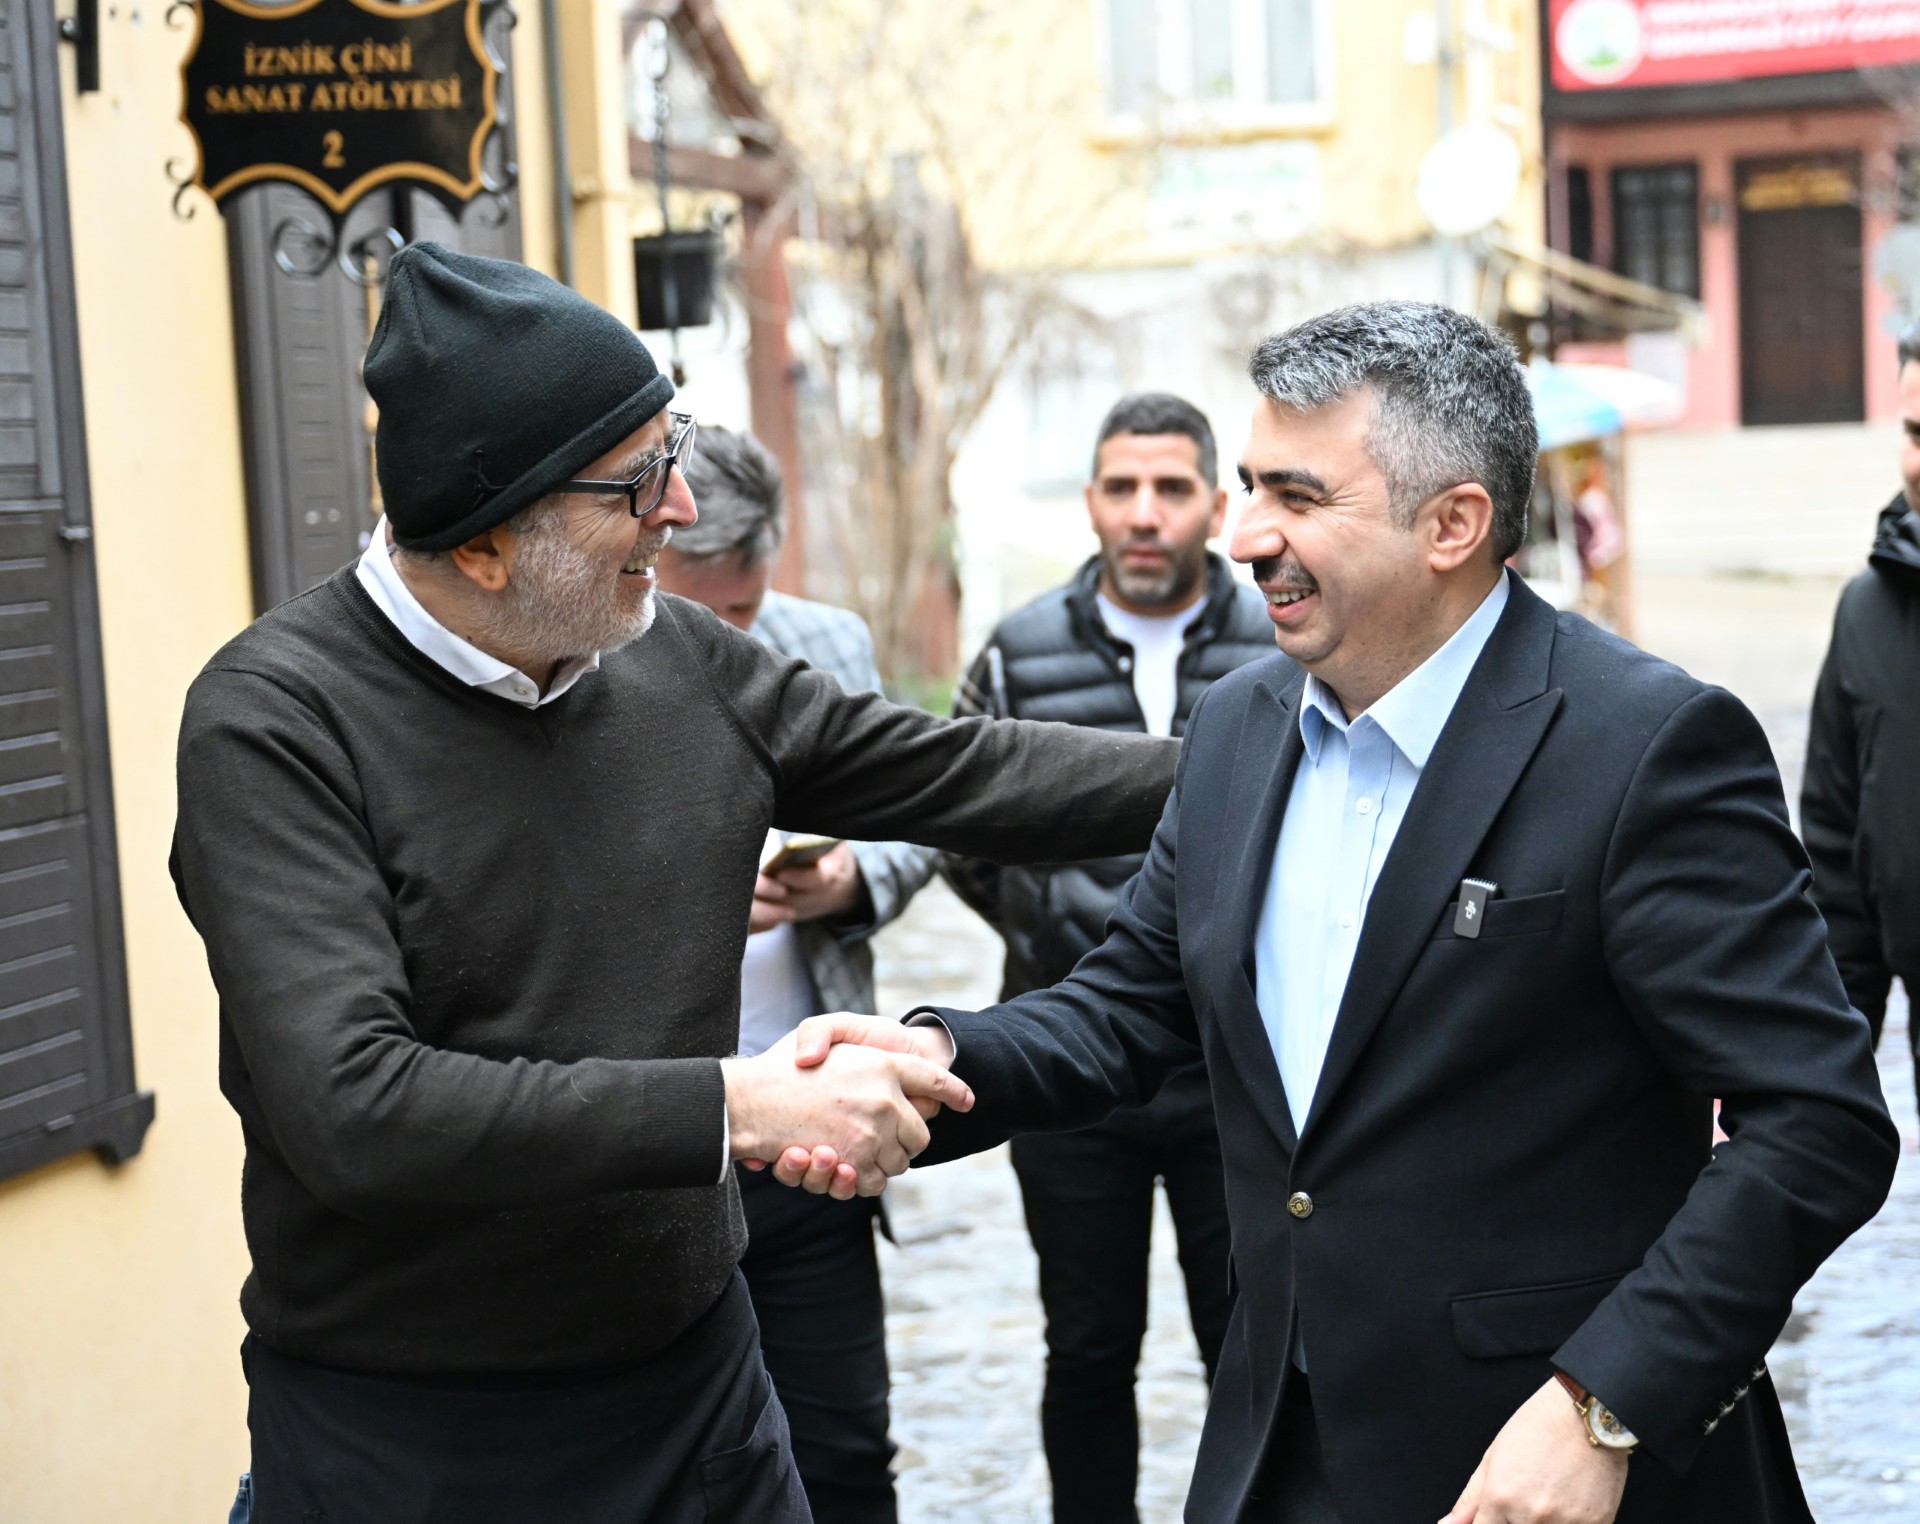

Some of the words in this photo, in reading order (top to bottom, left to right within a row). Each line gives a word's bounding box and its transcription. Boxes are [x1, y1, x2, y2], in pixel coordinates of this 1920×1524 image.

[244, 40, 335, 76] İZNİK
[340, 37, 413, 80] ÇİNİ
[205, 83, 304, 114] SANAT
[311, 73, 462, 110] ATÖLYESİ
[322, 129, 345, 168] 2
